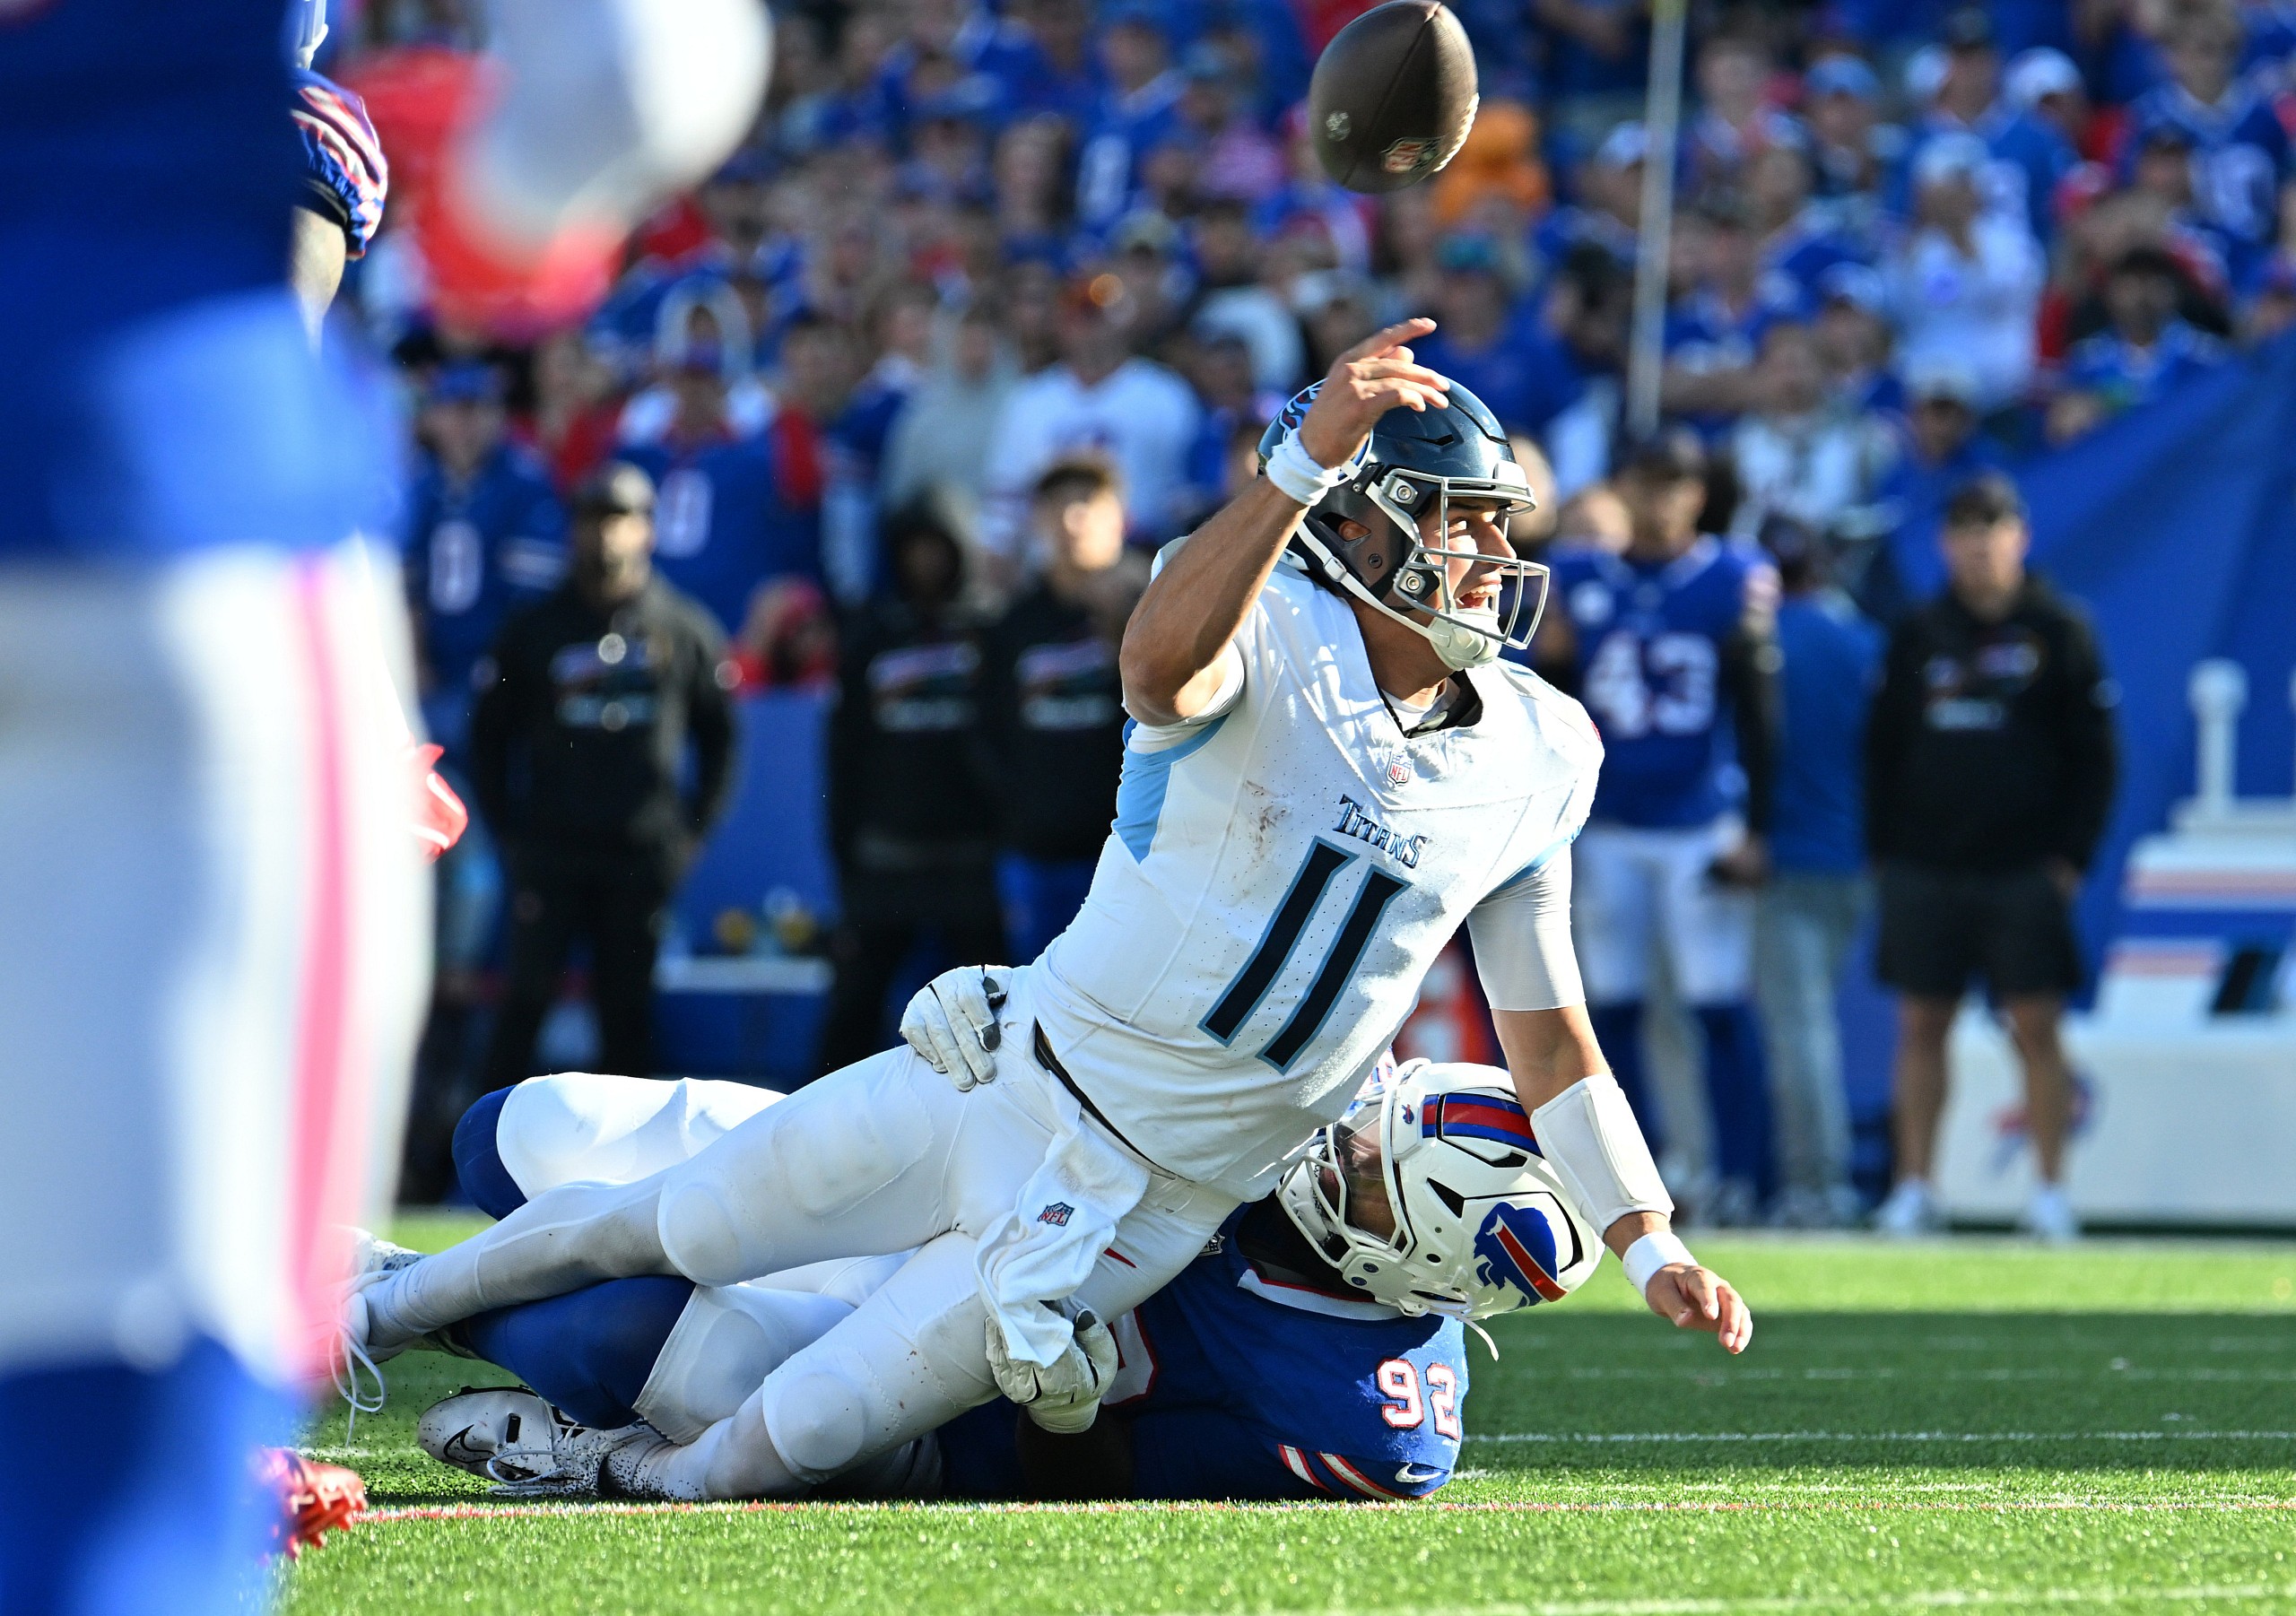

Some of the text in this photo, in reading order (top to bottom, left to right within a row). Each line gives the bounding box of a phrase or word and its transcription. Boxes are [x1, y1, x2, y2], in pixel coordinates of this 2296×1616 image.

[1584, 630, 1718, 737] 43
[1390, 764, 1407, 781] NFL
[1332, 793, 1428, 869] TITANS
[1197, 836, 1413, 1075] 11
[1040, 1212, 1065, 1224] NFL
[1377, 1357, 1460, 1442] 92
